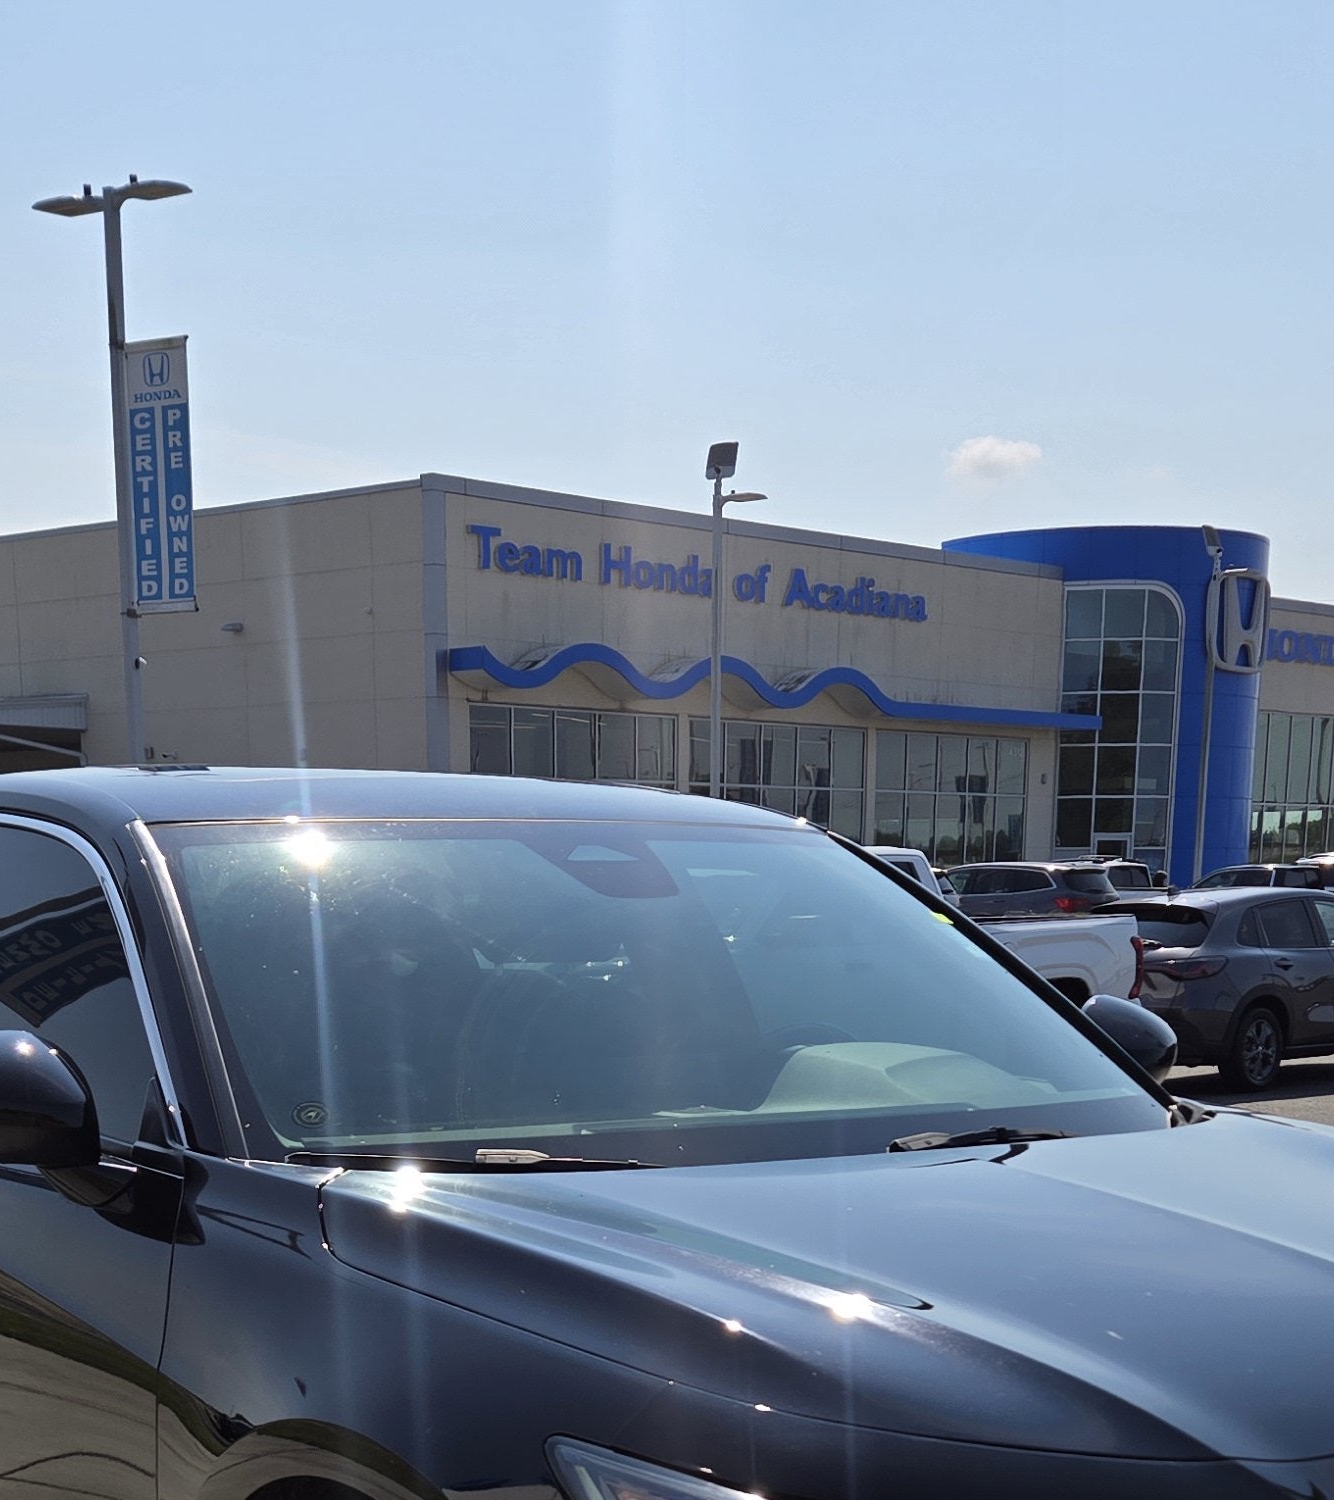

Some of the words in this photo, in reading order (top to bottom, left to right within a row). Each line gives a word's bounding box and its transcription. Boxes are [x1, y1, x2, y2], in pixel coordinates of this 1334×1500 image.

[133, 389, 182, 404] HONDA
[167, 409, 184, 469] PRE
[133, 412, 158, 597] CERTIFIED
[169, 494, 189, 595] OWNED
[466, 524, 583, 582] Team
[600, 543, 713, 599] Honda
[732, 564, 772, 604] of
[784, 568, 928, 622] Acadiana
